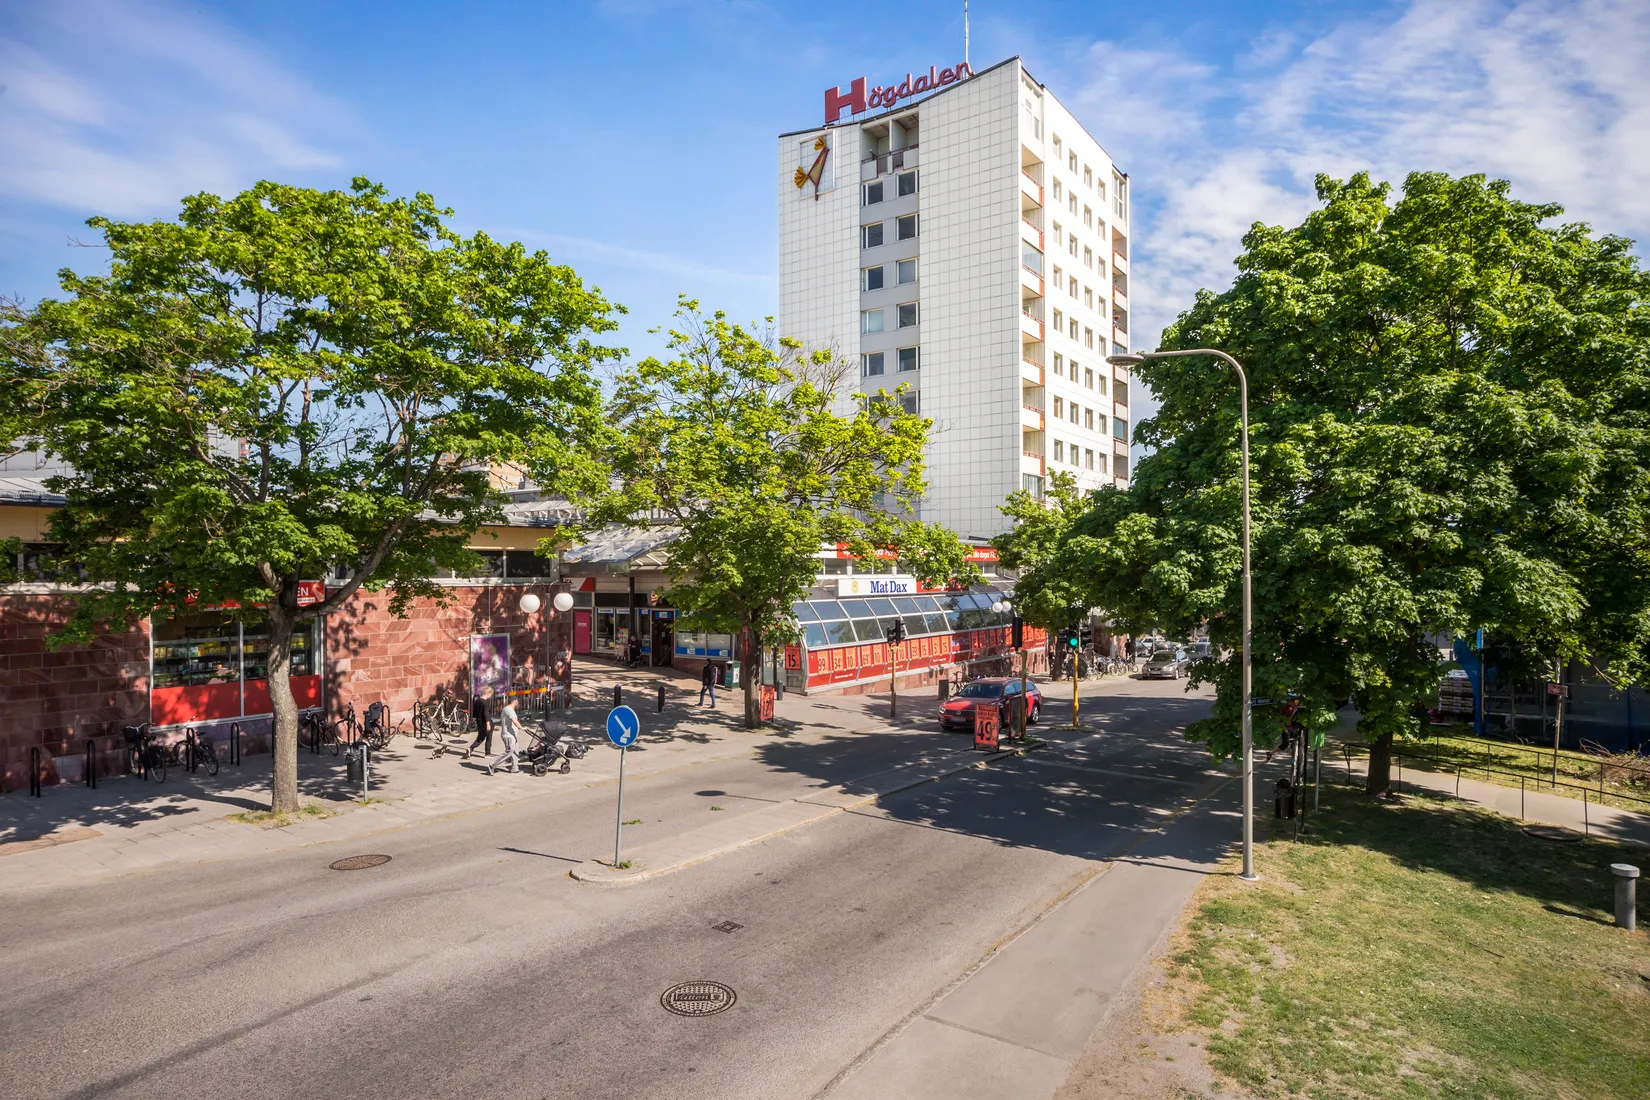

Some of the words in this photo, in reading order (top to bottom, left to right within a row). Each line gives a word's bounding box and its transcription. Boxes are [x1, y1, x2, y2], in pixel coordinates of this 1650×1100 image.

[824, 62, 976, 123] Högdalen
[870, 581, 889, 593] Mat
[889, 580, 907, 593] Dax
[788, 653, 796, 668] 15
[976, 720, 993, 741] 49
